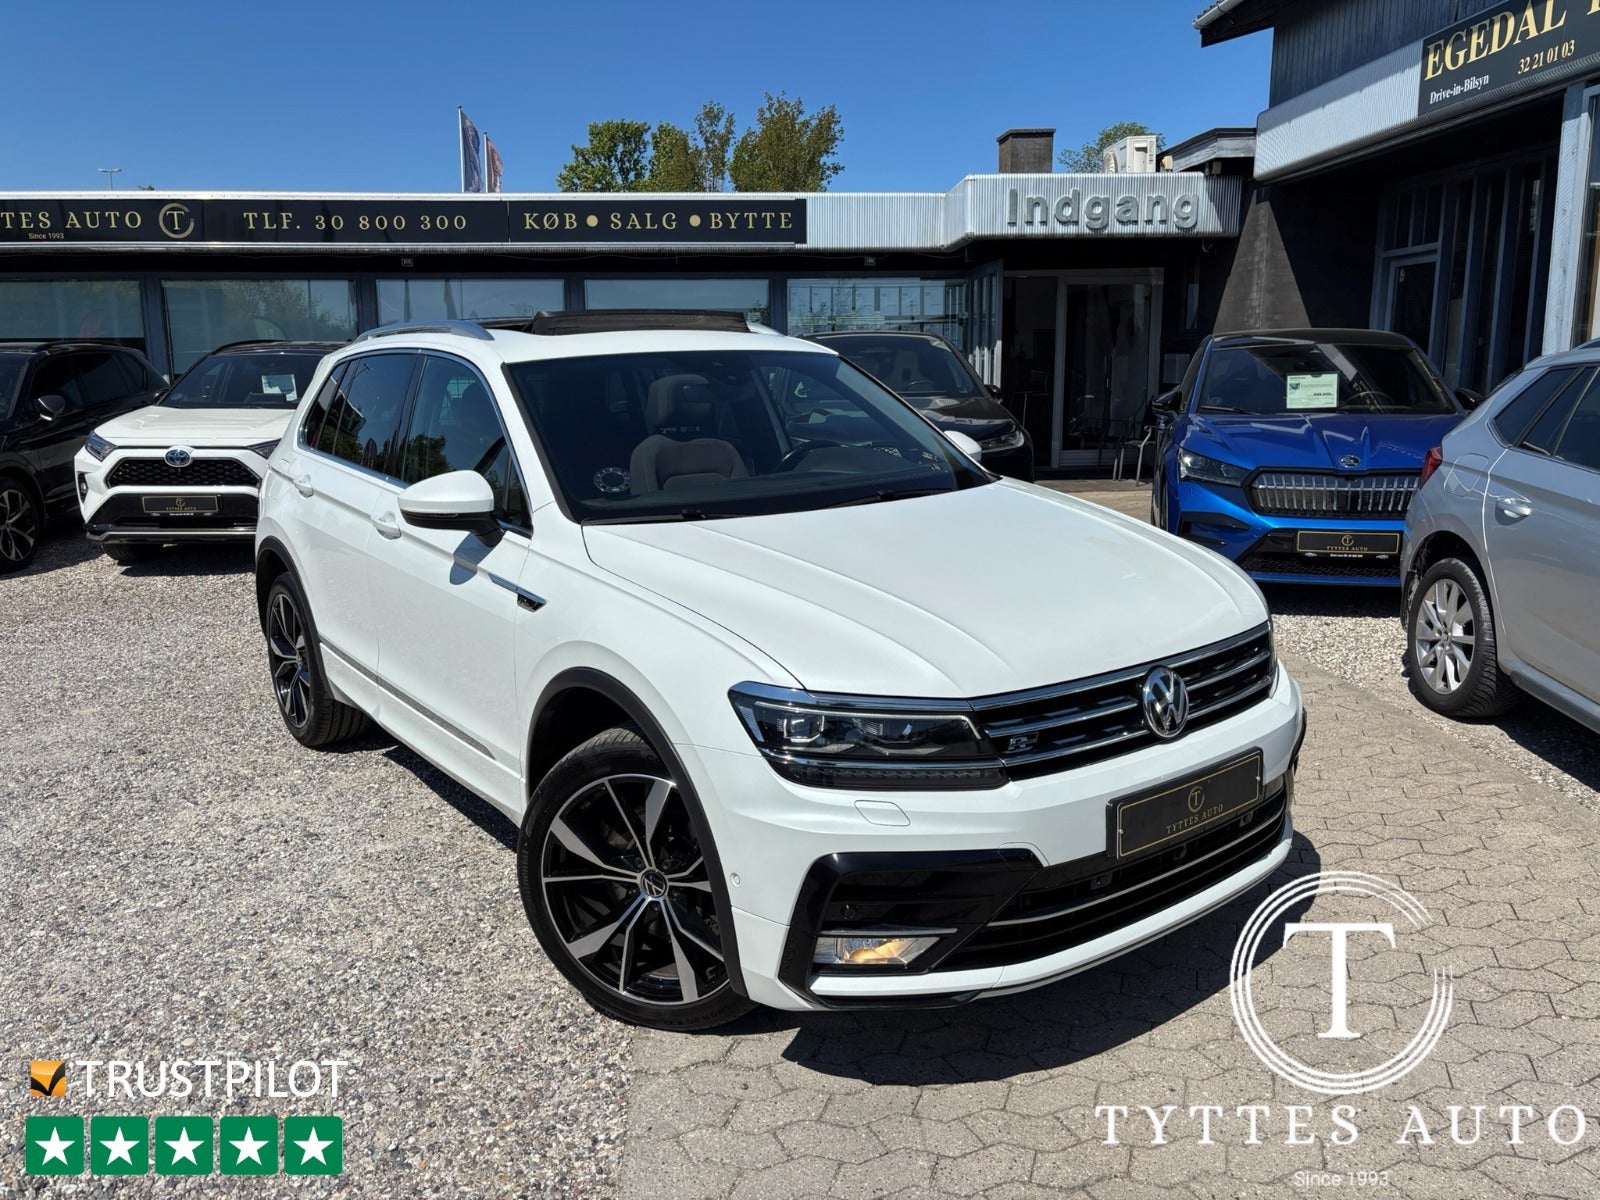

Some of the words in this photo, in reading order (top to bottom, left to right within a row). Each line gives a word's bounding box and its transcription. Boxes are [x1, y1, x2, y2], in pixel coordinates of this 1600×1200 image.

[1424, 0, 1567, 81] EGEDAL
[1517, 57, 1531, 74] 32
[1532, 53, 1544, 69] 21
[1547, 46, 1559, 63] 01
[1561, 39, 1575, 57] 03
[1429, 74, 1490, 104] Drive-in-Bilsyn
[65, 211, 142, 229] AUTO
[243, 212, 301, 230] TLF.
[315, 215, 344, 231] 30
[359, 215, 406, 231] 800
[420, 215, 467, 231] 300
[524, 212, 578, 230] KØB
[610, 212, 678, 231] SALG
[709, 212, 793, 230] BYTTE
[1007, 187, 1200, 231] Indgang
[29, 232, 47, 240] Since
[49, 232, 65, 240] 1993
[1166, 814, 1199, 834] TYTTES
[1201, 804, 1224, 820] AUTO
